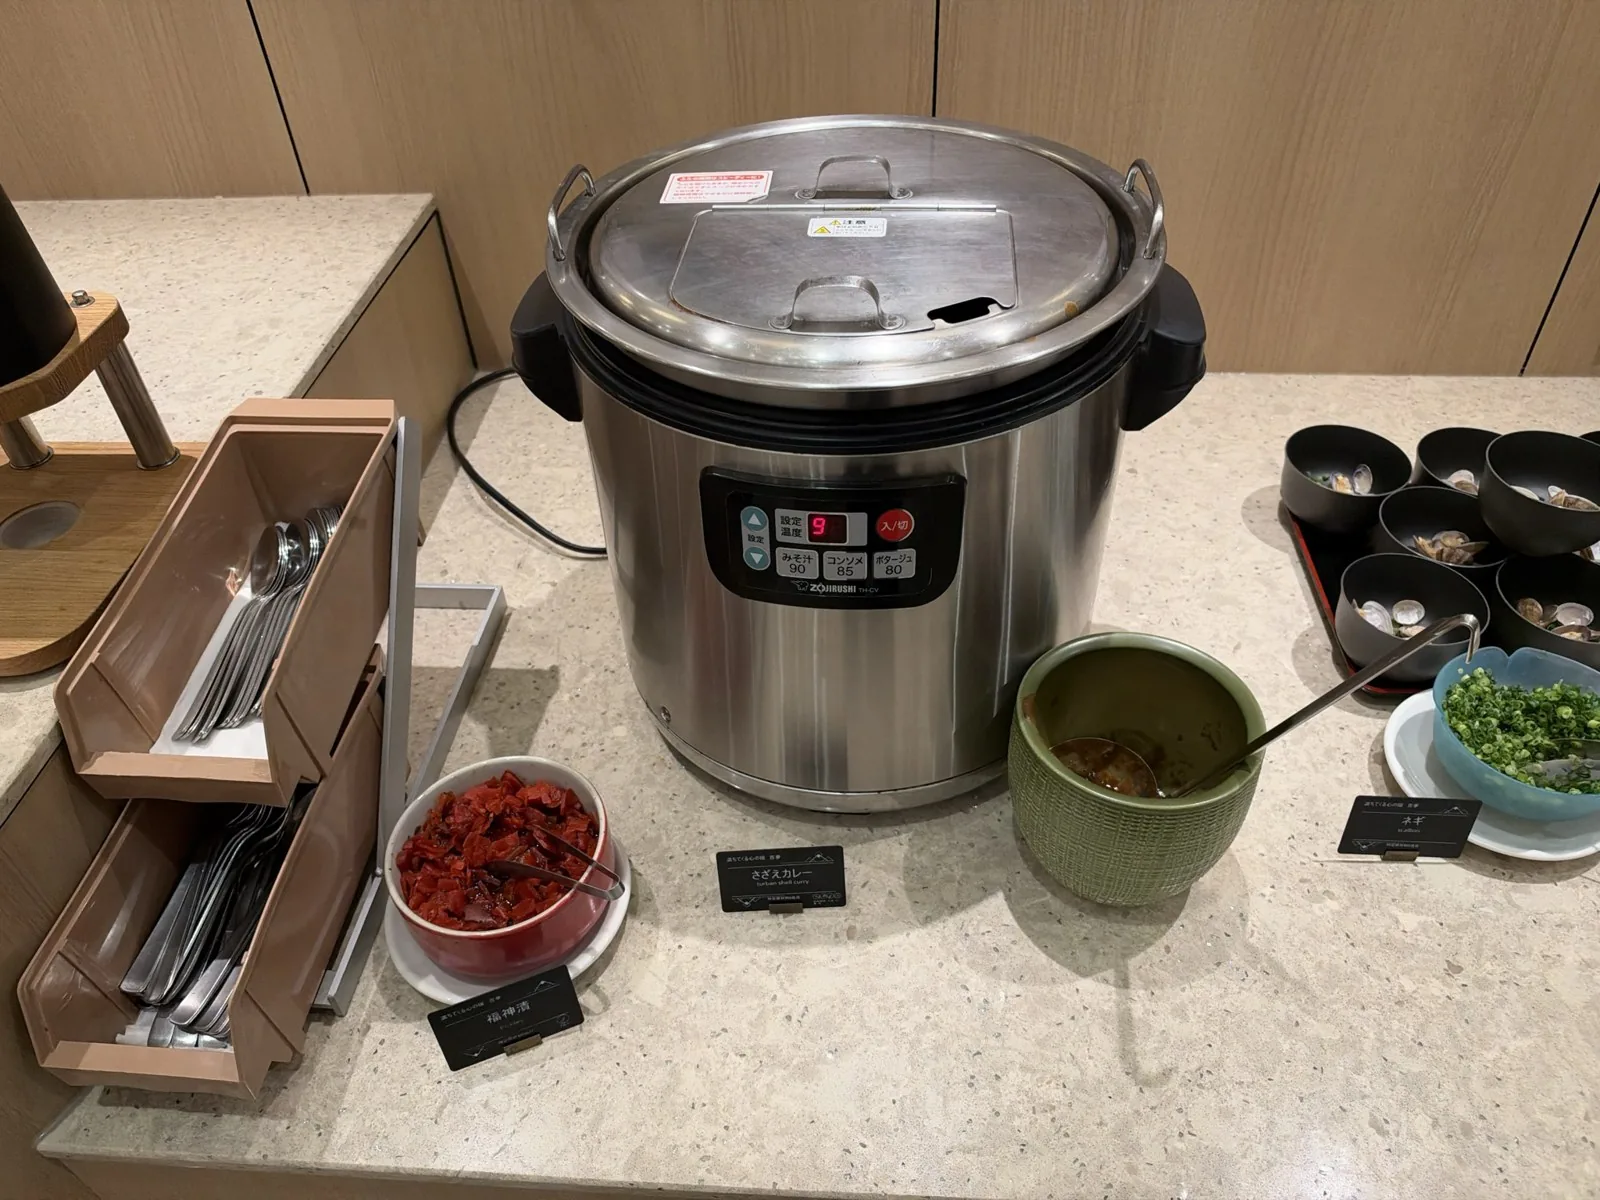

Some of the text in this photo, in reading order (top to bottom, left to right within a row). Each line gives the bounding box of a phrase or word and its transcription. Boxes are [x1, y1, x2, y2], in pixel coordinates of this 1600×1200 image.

[780, 515, 802, 527] 設定
[812, 517, 826, 535] 9
[881, 520, 909, 532] 入/切
[780, 526, 803, 538] 温度
[747, 535, 765, 544] 設定
[781, 553, 814, 563] みそ汁
[827, 556, 863, 566] コンソメ
[875, 552, 913, 565] ポタージュ
[789, 563, 806, 575] 90
[836, 566, 854, 577] 85
[885, 564, 902, 576] 80
[809, 583, 857, 594] ZOJIRUSHI
[1401, 815, 1426, 826] ネギ
[751, 868, 813, 881] さざえカレー
[486, 1000, 531, 1024] 福神漬
